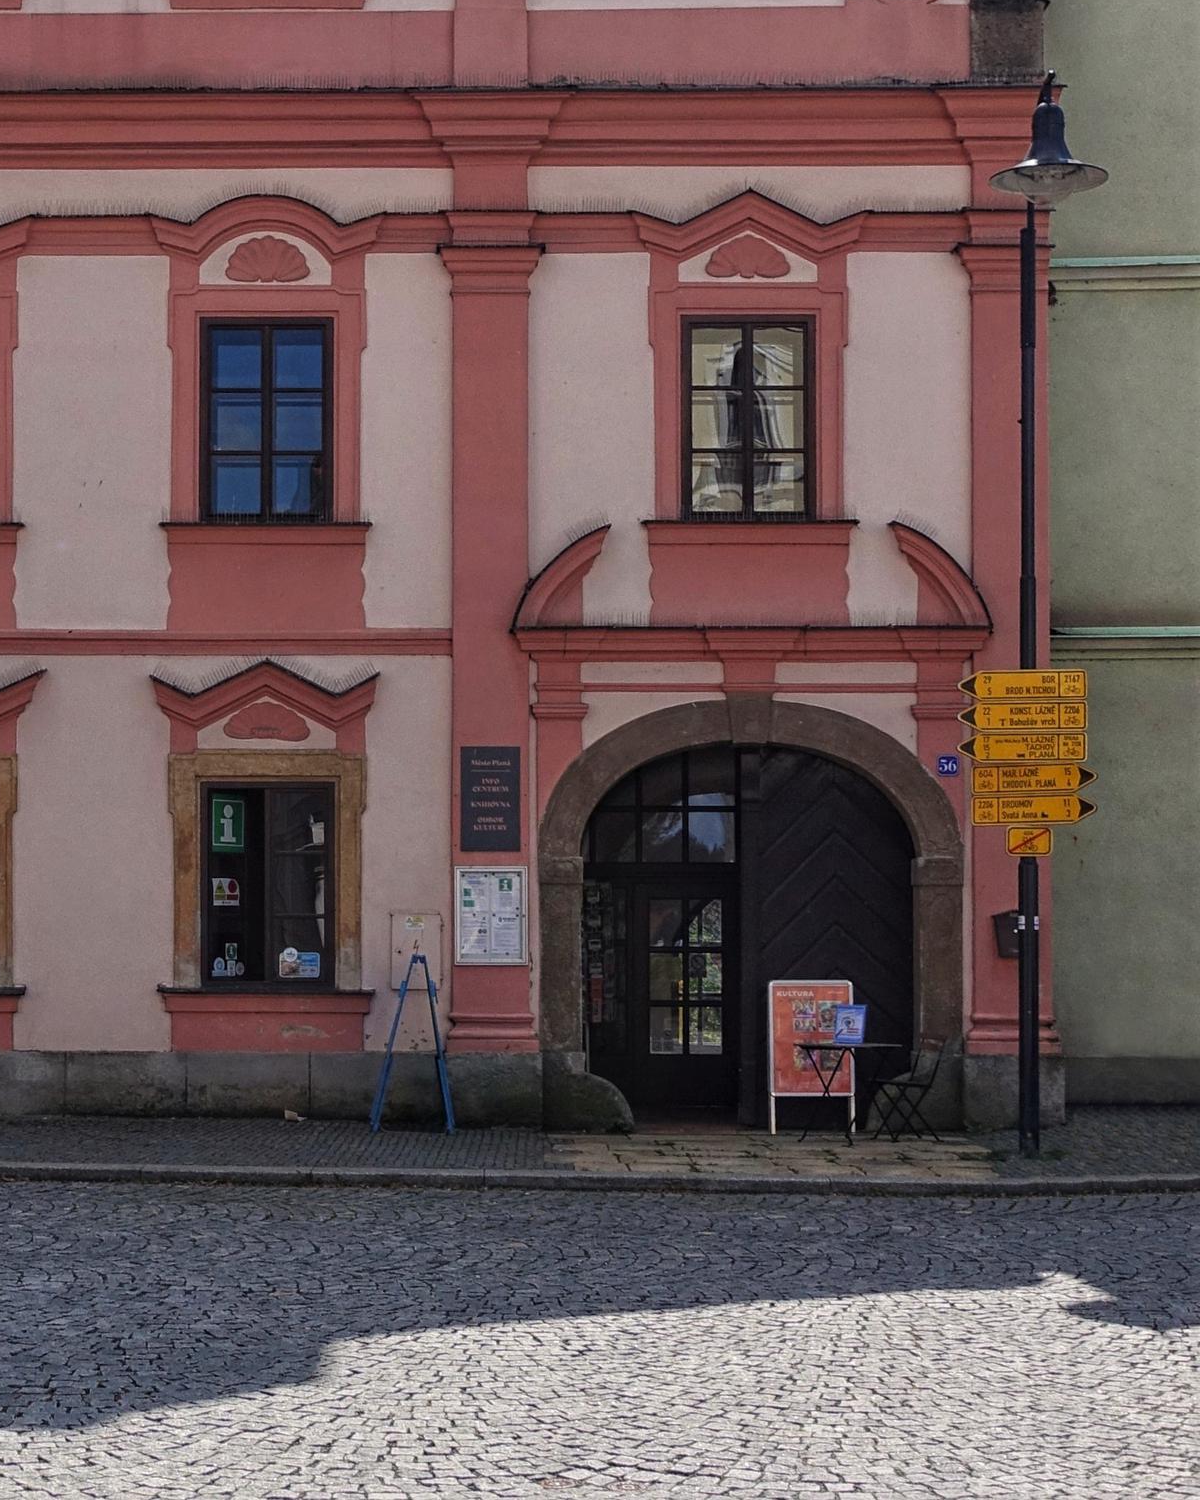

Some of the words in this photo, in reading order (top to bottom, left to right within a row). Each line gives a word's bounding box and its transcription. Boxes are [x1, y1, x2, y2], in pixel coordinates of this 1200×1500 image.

[983, 675, 992, 684] 29
[1041, 675, 1056, 684] BOR
[1064, 674, 1080, 683] 2167
[1005, 686, 1024, 695] BROD
[983, 707, 991, 716] 22
[1064, 706, 1080, 715] 2206
[1040, 718, 1056, 726] vrch
[1025, 743, 1055, 751] TACHOV
[939, 758, 957, 772] 56
[978, 770, 993, 778] 604
[1064, 767, 1072, 775] 15
[481, 777, 500, 785] INFO
[1002, 779, 1032, 789] CHODOVÁ
[1035, 778, 1057, 788] PLANÁ
[978, 801, 993, 809] 2206
[1002, 800, 1033, 809] BROUMOV
[1063, 799, 1070, 807] 11
[1021, 811, 1038, 819] Anna
